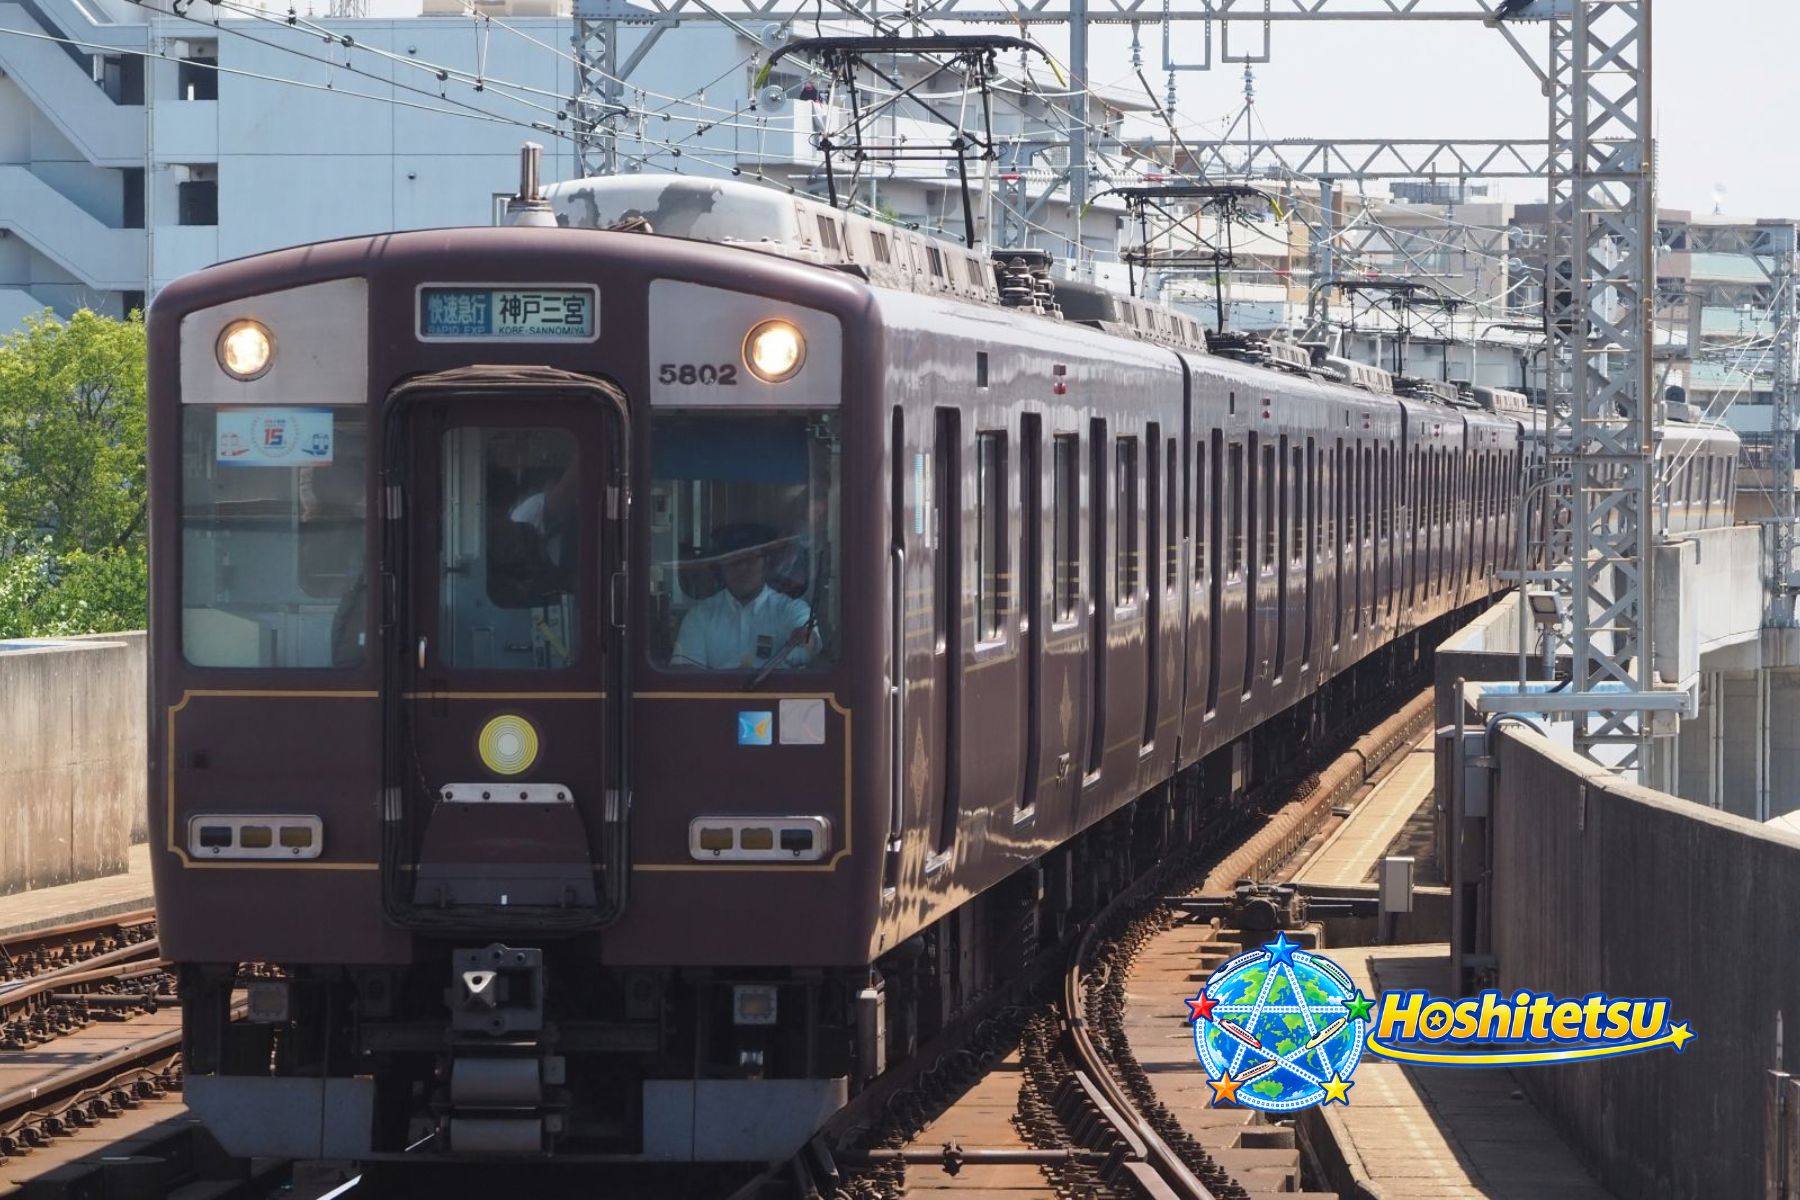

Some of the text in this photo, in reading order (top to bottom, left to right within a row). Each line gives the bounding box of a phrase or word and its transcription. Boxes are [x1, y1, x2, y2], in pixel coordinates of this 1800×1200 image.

[428, 294, 487, 324] 快速急行
[500, 295, 586, 325] 神戸三宮
[659, 364, 737, 385] 5802
[264, 428, 284, 446] 15
